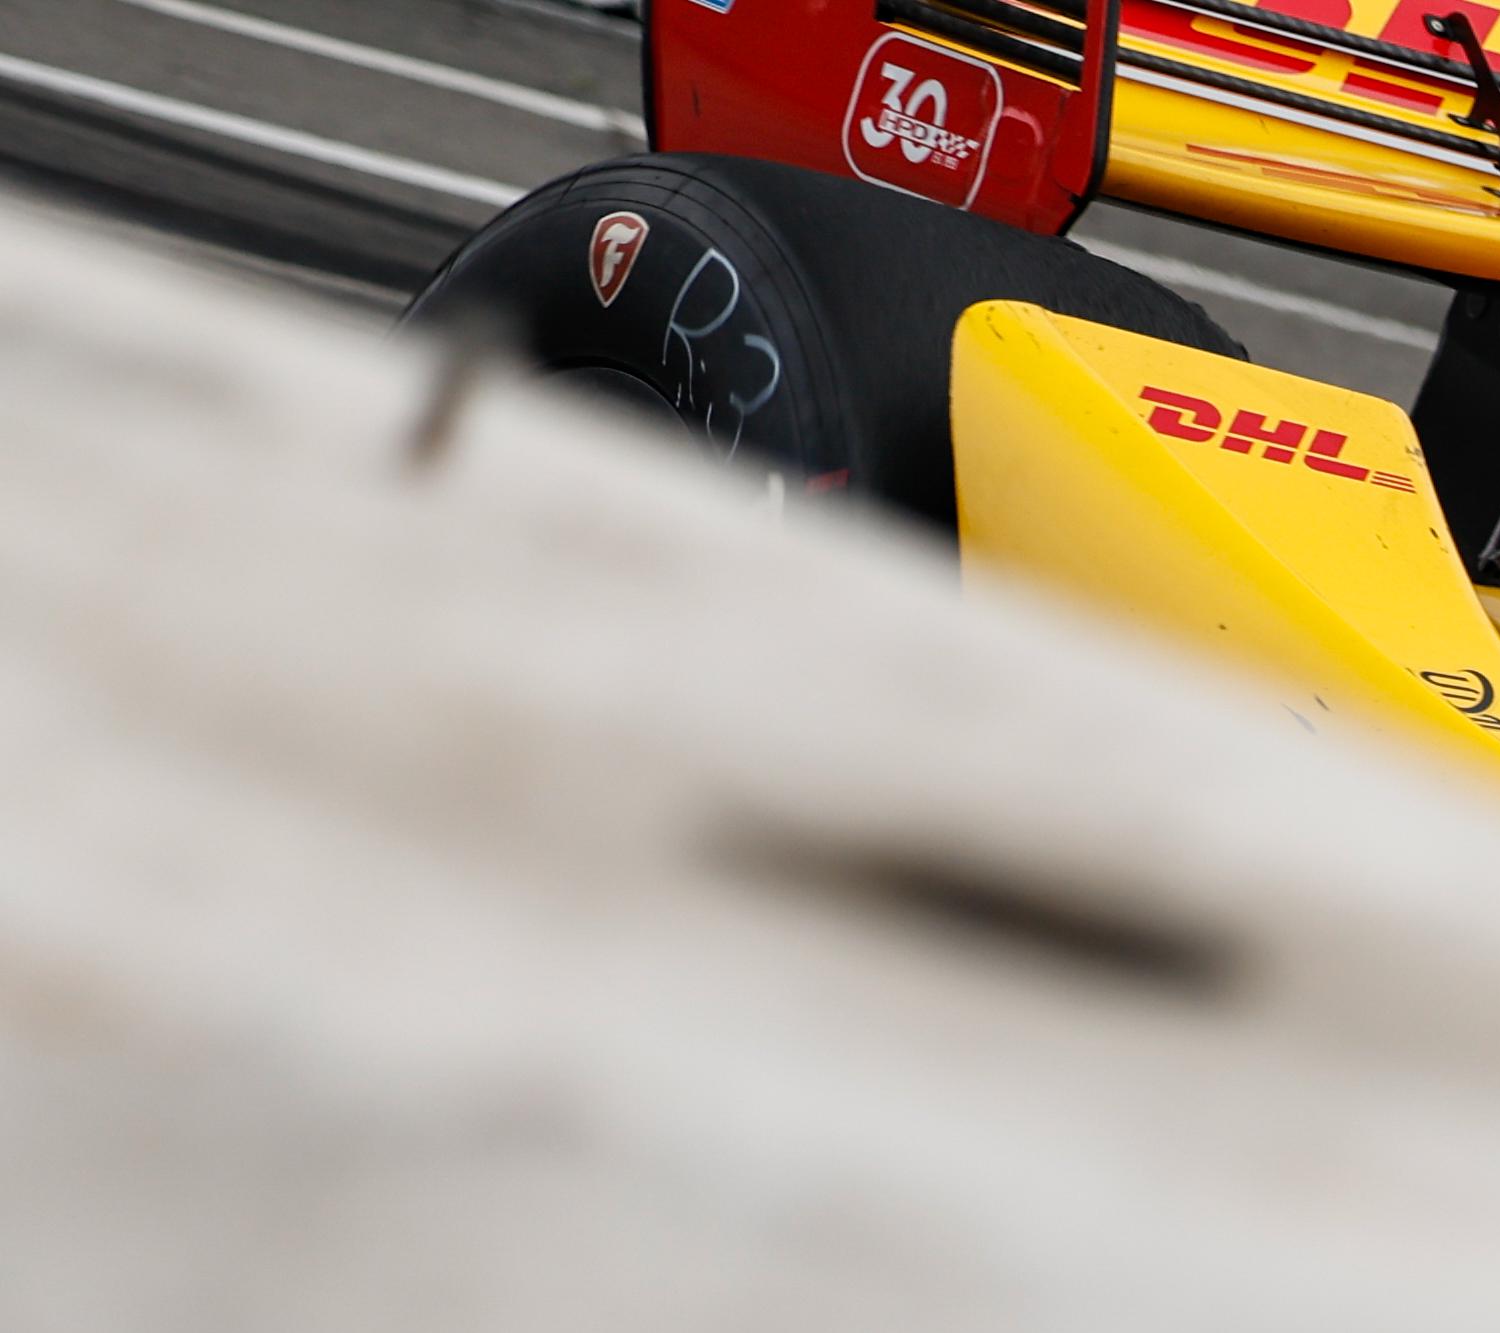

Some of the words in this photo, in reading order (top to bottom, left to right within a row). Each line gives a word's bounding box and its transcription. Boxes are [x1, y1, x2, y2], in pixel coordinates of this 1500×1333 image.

[860, 62, 947, 163] 30
[885, 113, 928, 140] HPD
[1139, 386, 1371, 483] DHL
